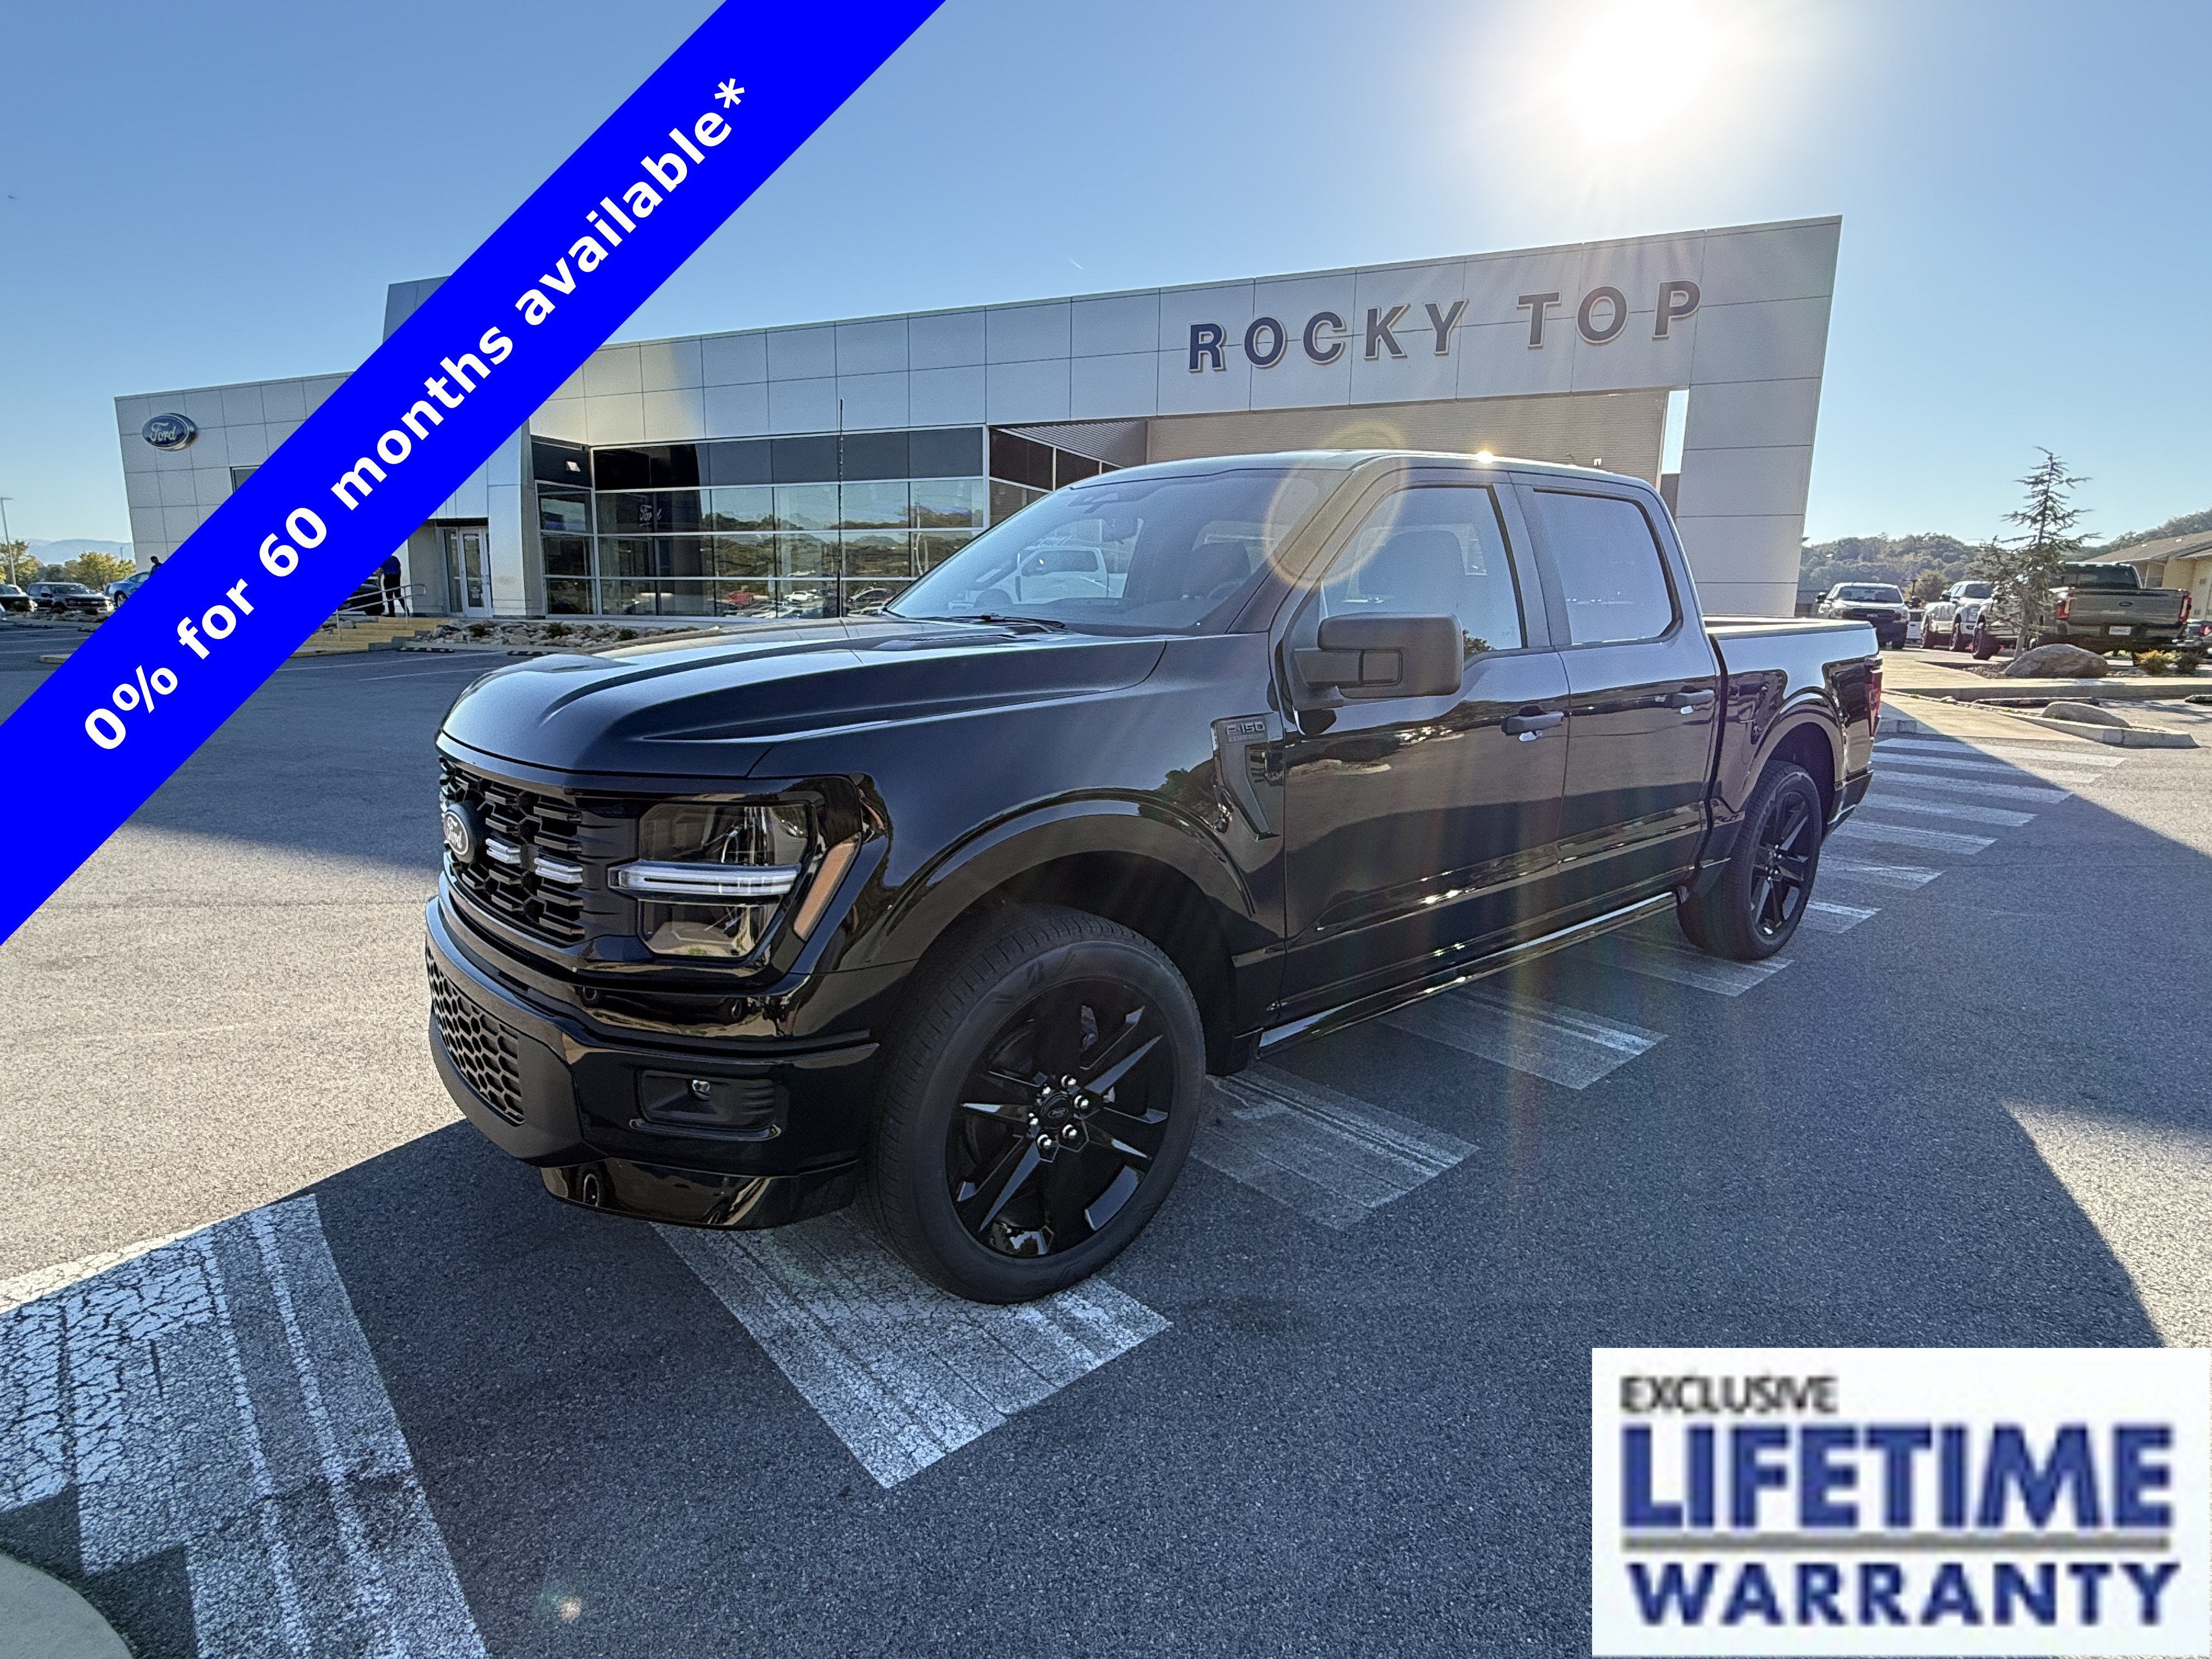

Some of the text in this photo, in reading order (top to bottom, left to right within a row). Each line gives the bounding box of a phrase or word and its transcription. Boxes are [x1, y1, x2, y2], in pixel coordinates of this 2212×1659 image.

[1188, 280, 1701, 372] ROCKY TOP
[150, 422, 177, 442] Ford
[1226, 721, 1265, 735] F-150
[447, 816, 462, 849] Ford
